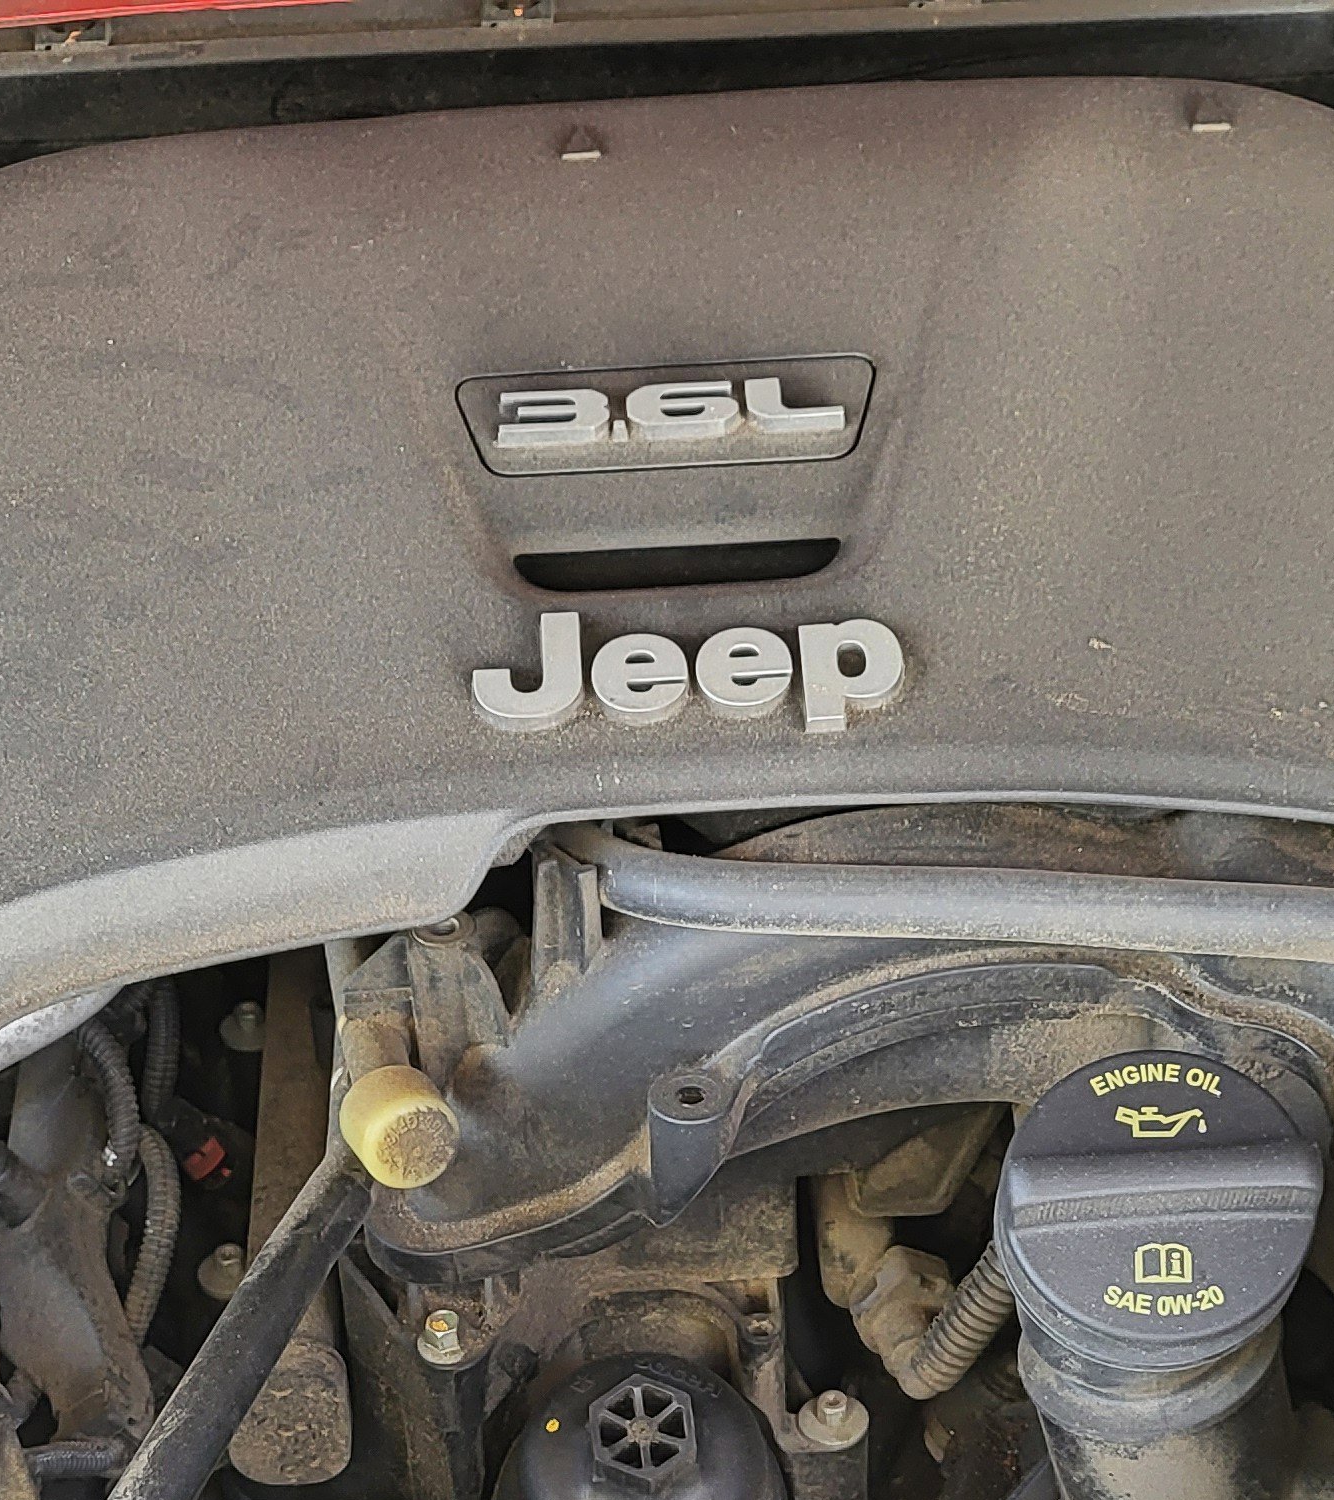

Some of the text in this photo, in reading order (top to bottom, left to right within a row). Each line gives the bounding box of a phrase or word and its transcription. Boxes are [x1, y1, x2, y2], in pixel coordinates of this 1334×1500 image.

[493, 376, 846, 448] 3.6L
[471, 610, 906, 733] Jeep
[1089, 1063, 1223, 1098] ENGINE OIL
[1103, 1284, 1225, 1317] SAE 0W-20
